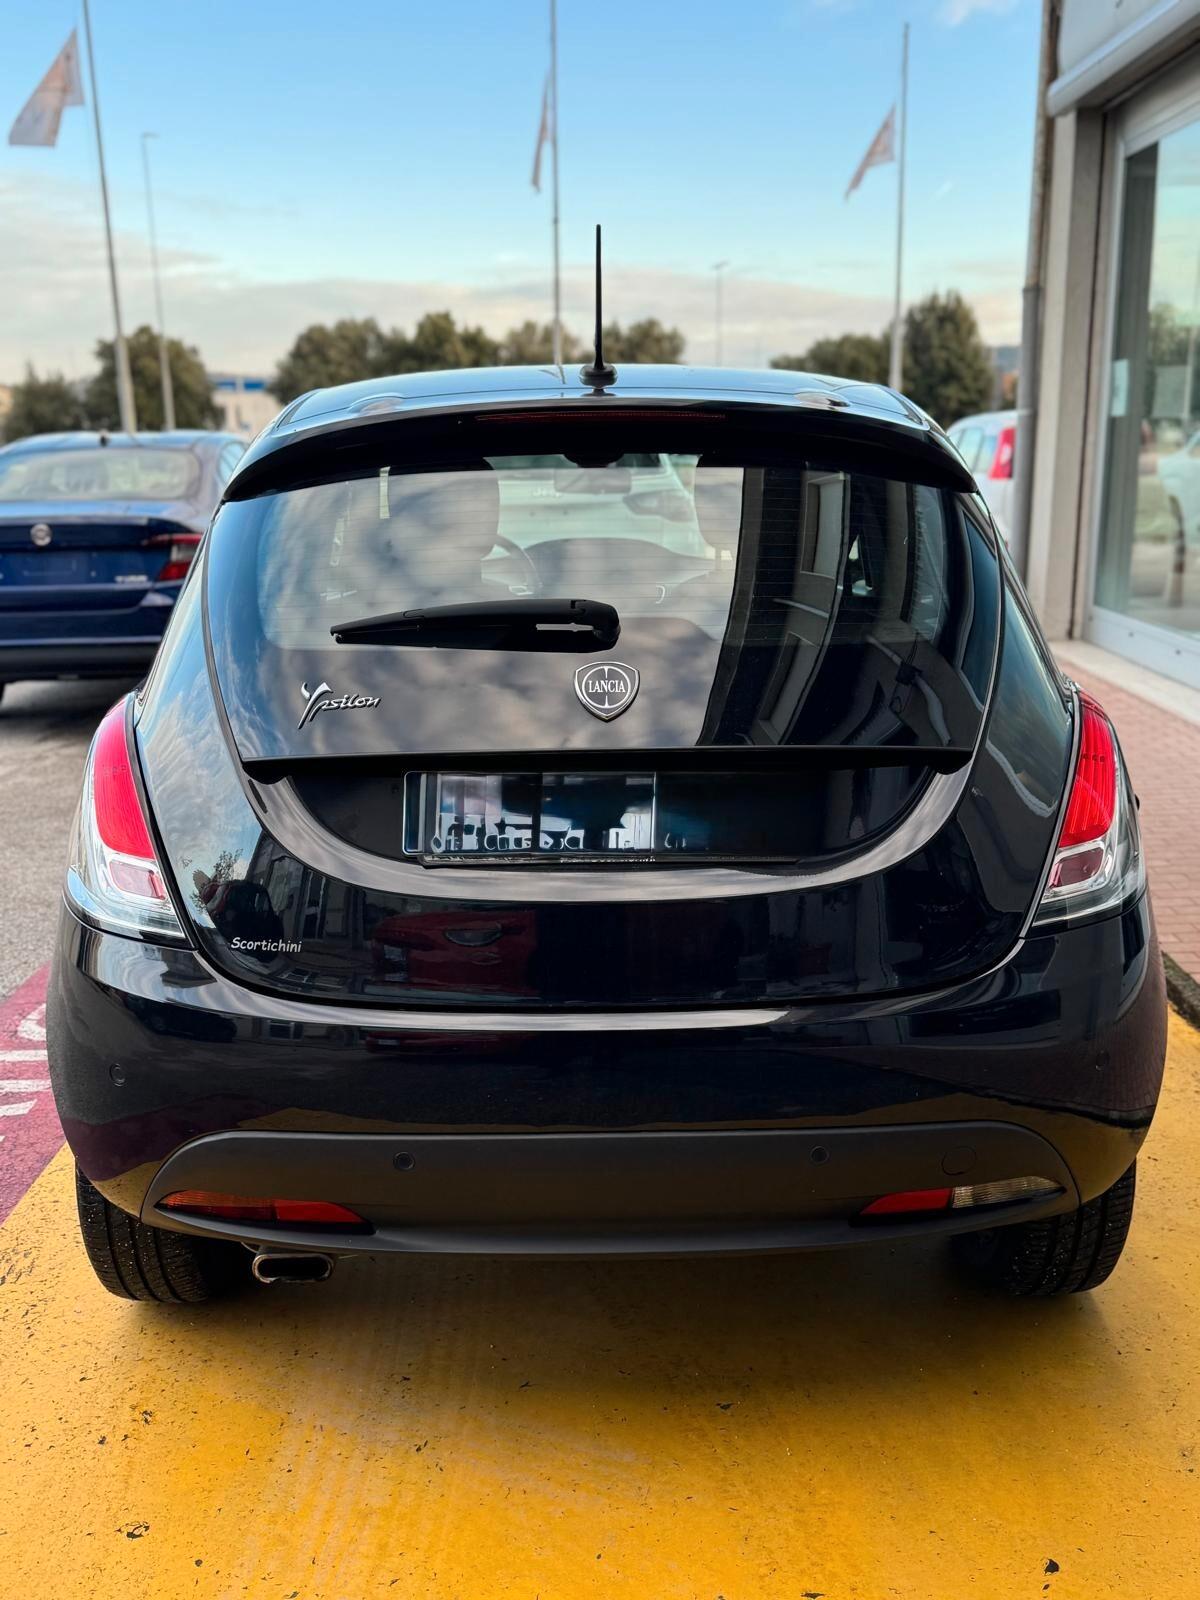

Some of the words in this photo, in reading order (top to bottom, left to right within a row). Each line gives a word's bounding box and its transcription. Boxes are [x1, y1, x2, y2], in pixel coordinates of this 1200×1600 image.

[588, 680, 625, 693] LANCIA
[298, 682, 381, 729] Ypsilon
[230, 936, 302, 953] Scortichini
